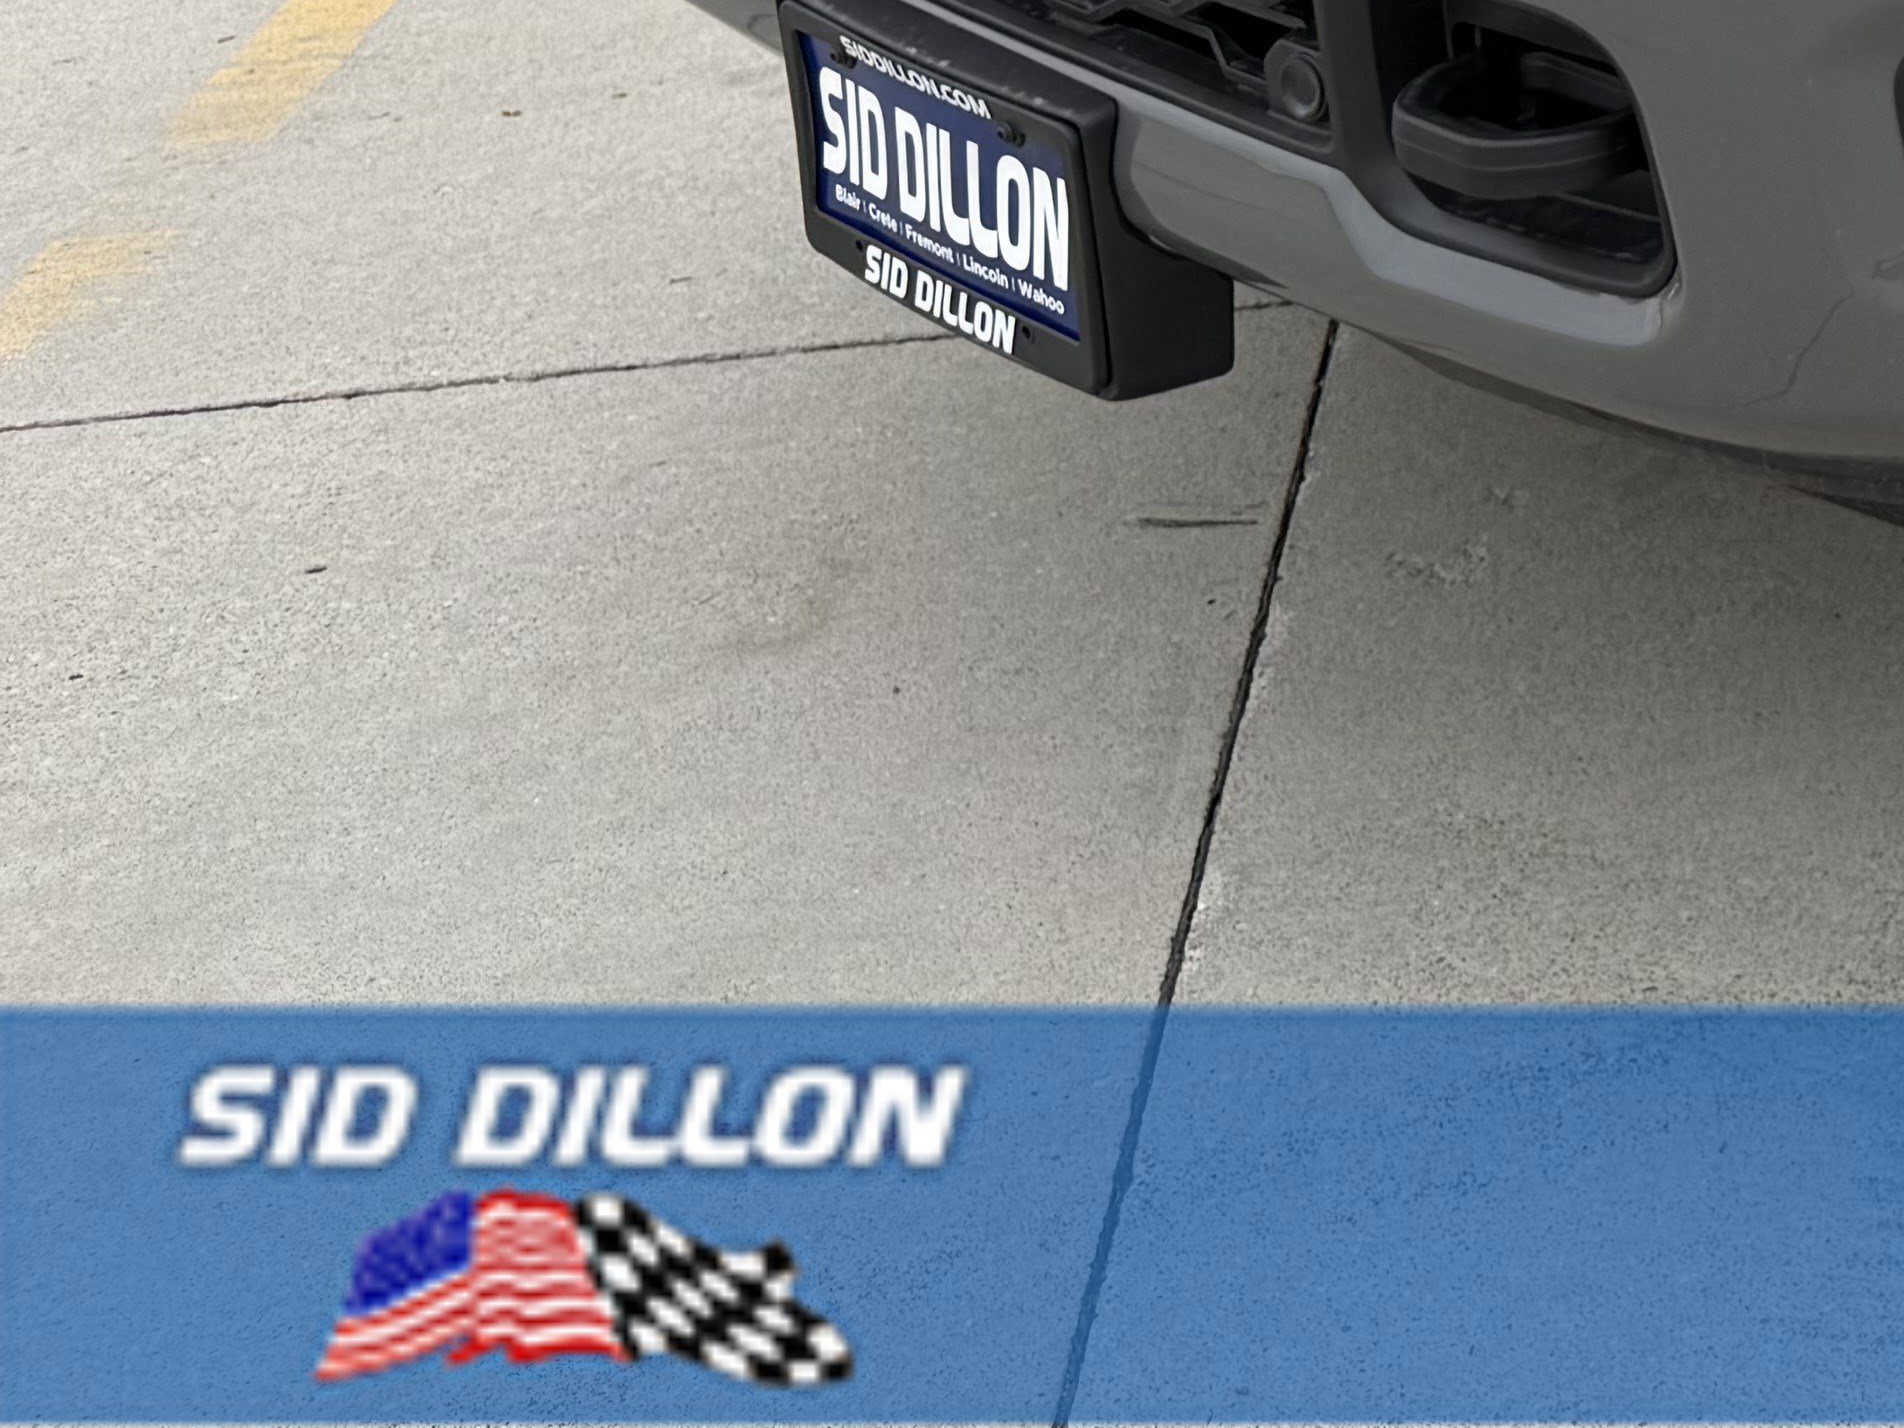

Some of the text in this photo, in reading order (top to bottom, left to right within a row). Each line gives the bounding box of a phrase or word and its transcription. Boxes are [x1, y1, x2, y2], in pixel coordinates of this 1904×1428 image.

[839, 35, 993, 120] SIDDILLON.COM
[819, 65, 1070, 292] SID DILLON
[835, 183, 1066, 316] Blair Crete Fremont Lincoln Wahoo
[864, 244, 1017, 355] SID DILLON
